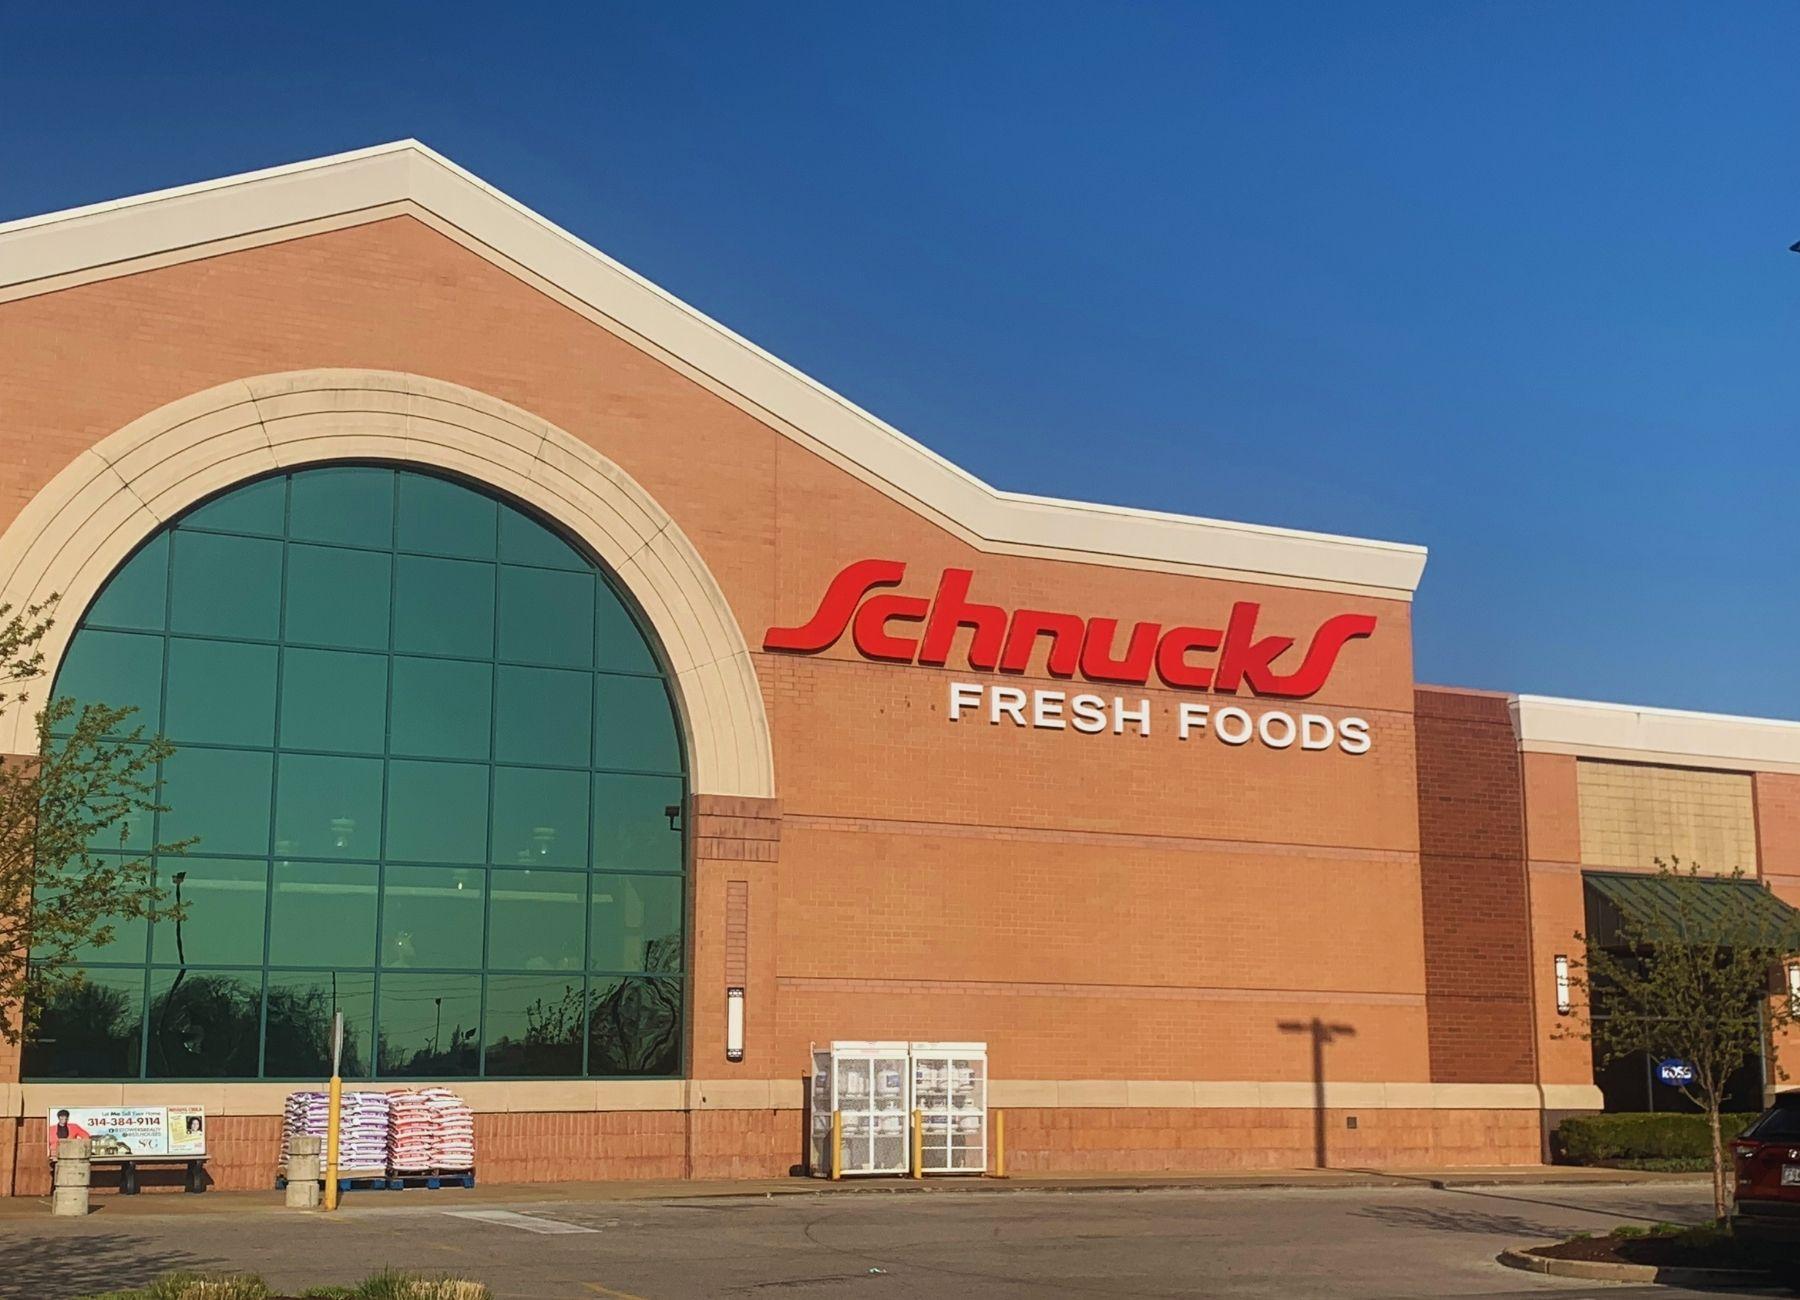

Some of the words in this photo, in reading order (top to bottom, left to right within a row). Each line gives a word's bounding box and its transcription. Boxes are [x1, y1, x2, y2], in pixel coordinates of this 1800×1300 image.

[763, 559, 1378, 699] Schnucks
[949, 682, 1151, 735] FRESH
[1178, 703, 1372, 754] FOODS
[1661, 1066, 1692, 1079] ROSS
[87, 1117, 161, 1126] 314-384-9114
